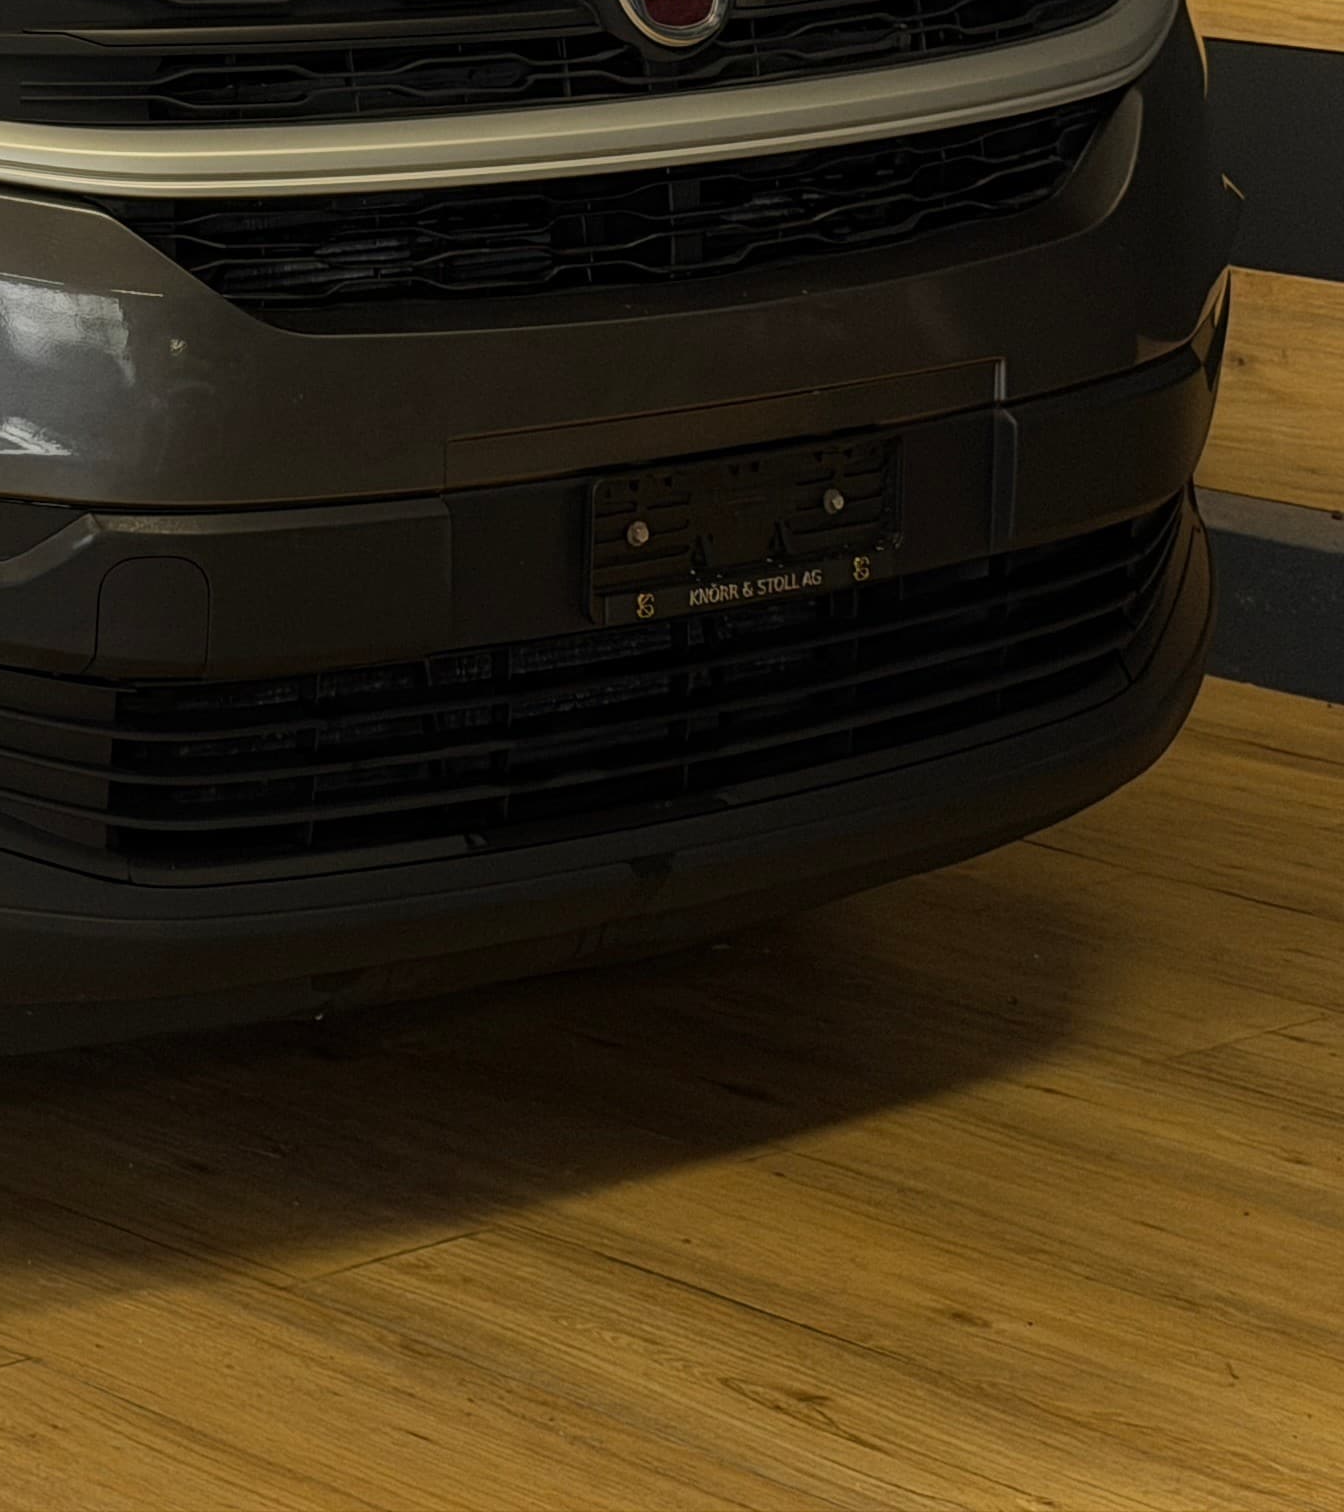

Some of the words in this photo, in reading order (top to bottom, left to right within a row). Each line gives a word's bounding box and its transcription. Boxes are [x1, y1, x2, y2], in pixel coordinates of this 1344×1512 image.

[689, 583, 740, 606] KNÖRR
[742, 581, 753, 598] &
[757, 573, 800, 596] STOLL
[802, 569, 823, 587] AG
